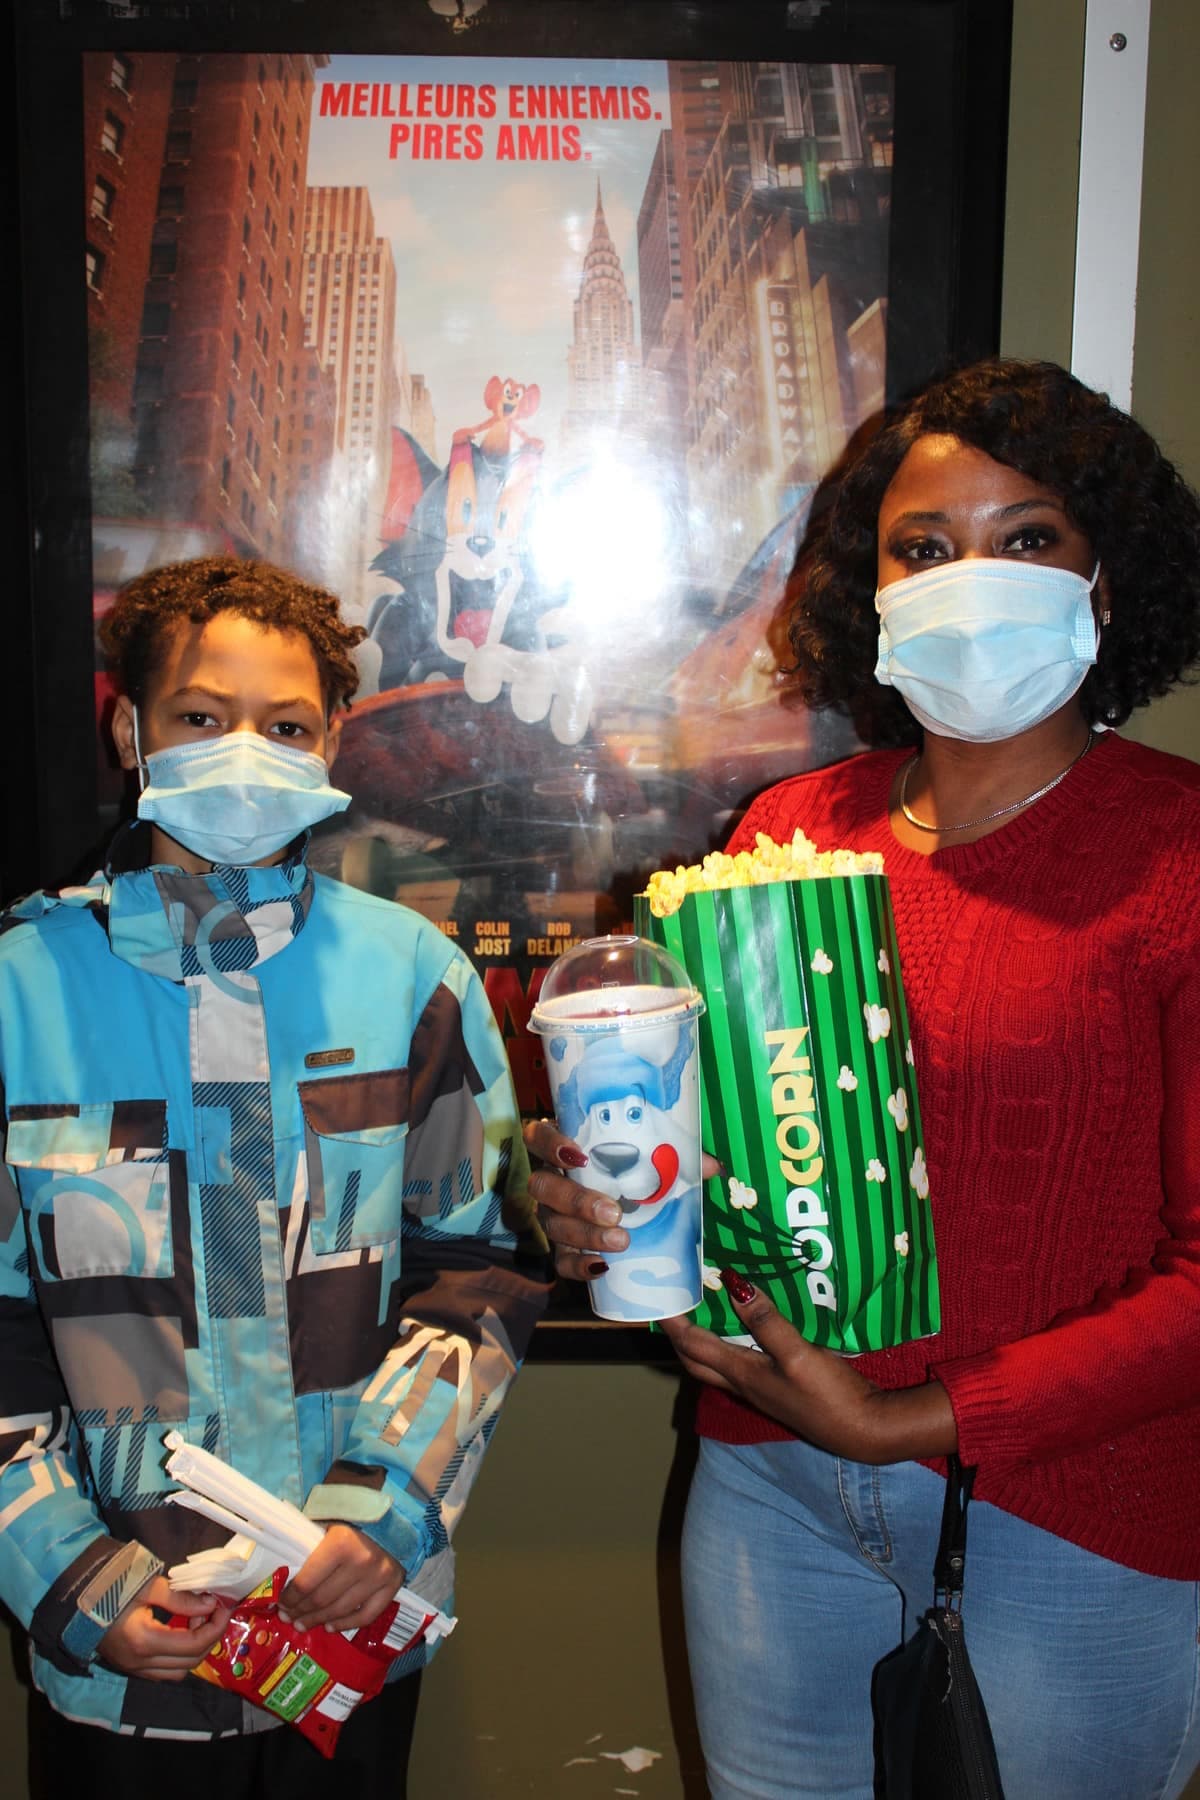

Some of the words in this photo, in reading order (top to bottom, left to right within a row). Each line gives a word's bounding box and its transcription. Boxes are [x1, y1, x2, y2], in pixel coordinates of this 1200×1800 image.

[320, 83, 497, 119] MEILLEURS
[508, 85, 663, 121] ENNEMIS.
[389, 124, 484, 160] PIRES
[496, 125, 592, 161] AMIS.
[771, 302, 802, 464] BROADWAY
[474, 939, 511, 955] JOST
[476, 922, 510, 935] COLIN
[547, 923, 571, 936] ROB
[766, 1027, 836, 1310] POPCORN
